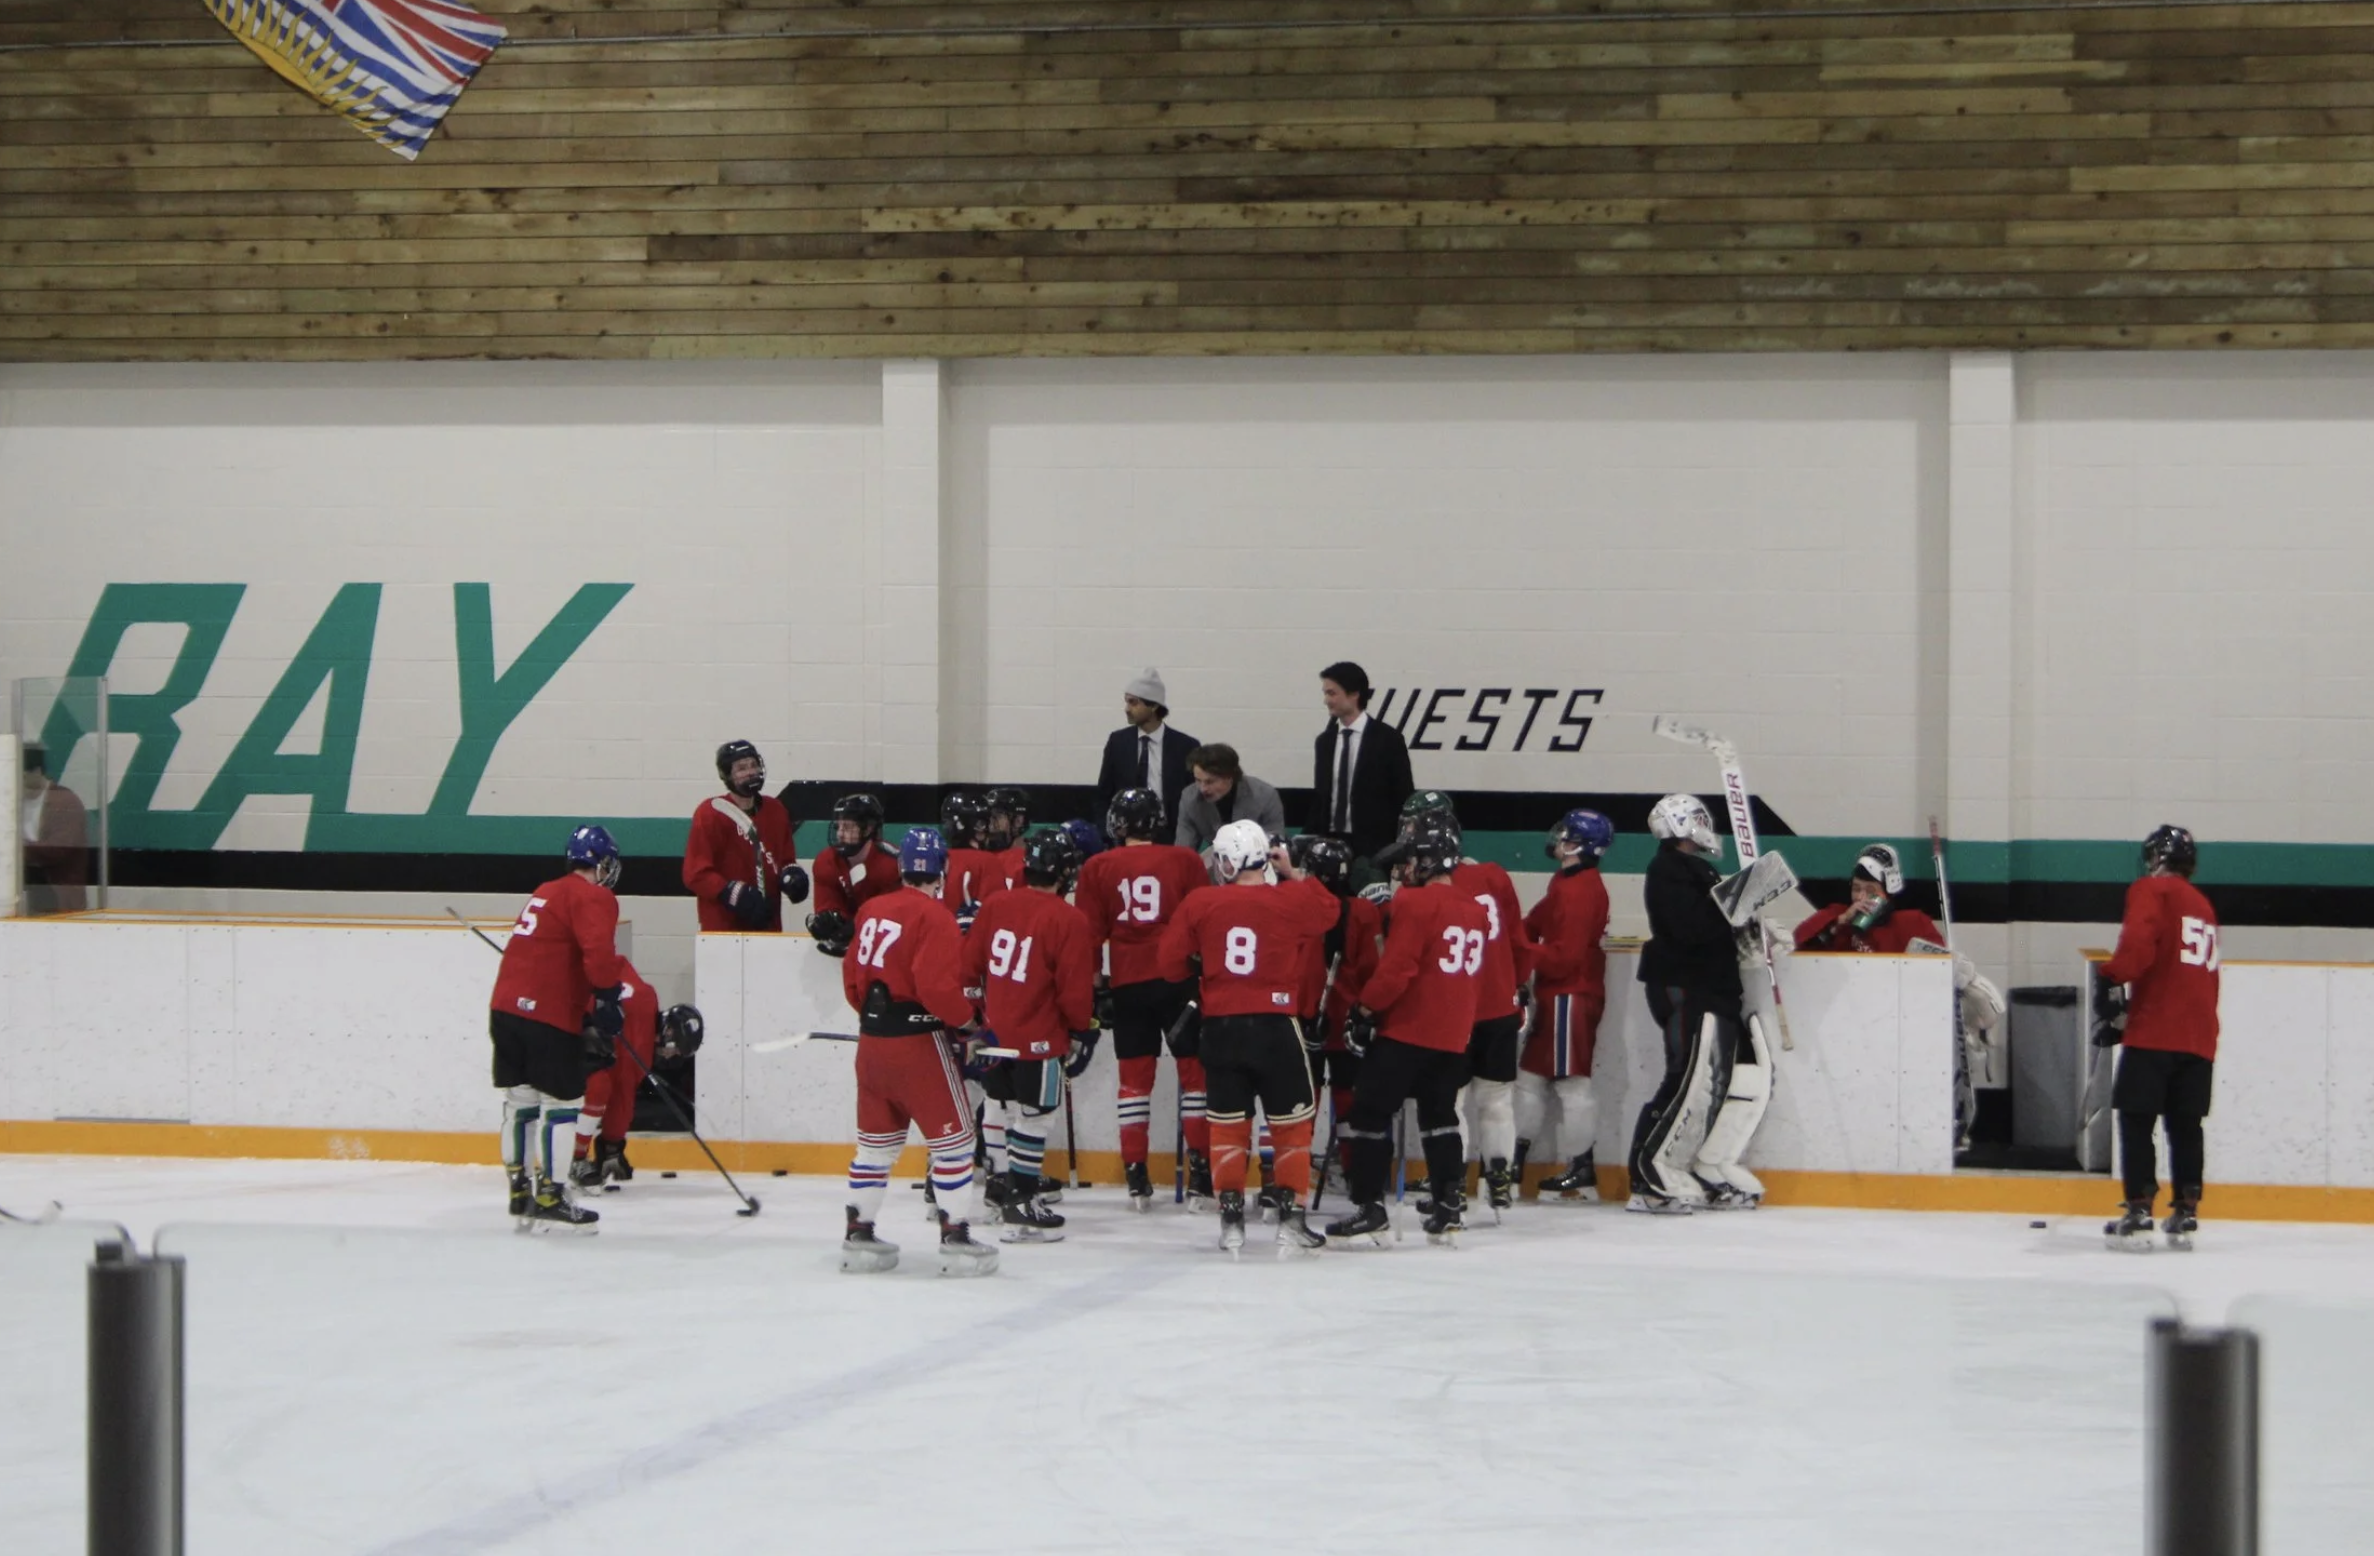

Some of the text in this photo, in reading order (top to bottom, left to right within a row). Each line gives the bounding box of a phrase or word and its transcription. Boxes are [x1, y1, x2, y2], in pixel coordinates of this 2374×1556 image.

[38, 583, 635, 851] RAY
[1325, 688, 1604, 751] UESTS
[1725, 773, 1755, 858] BAUER
[914, 859, 926, 871] 21
[1117, 876, 1160, 921] 19
[858, 918, 902, 968] 87
[988, 928, 1033, 982] 91
[1224, 926, 1257, 975] 8
[1439, 926, 1484, 976] 33
